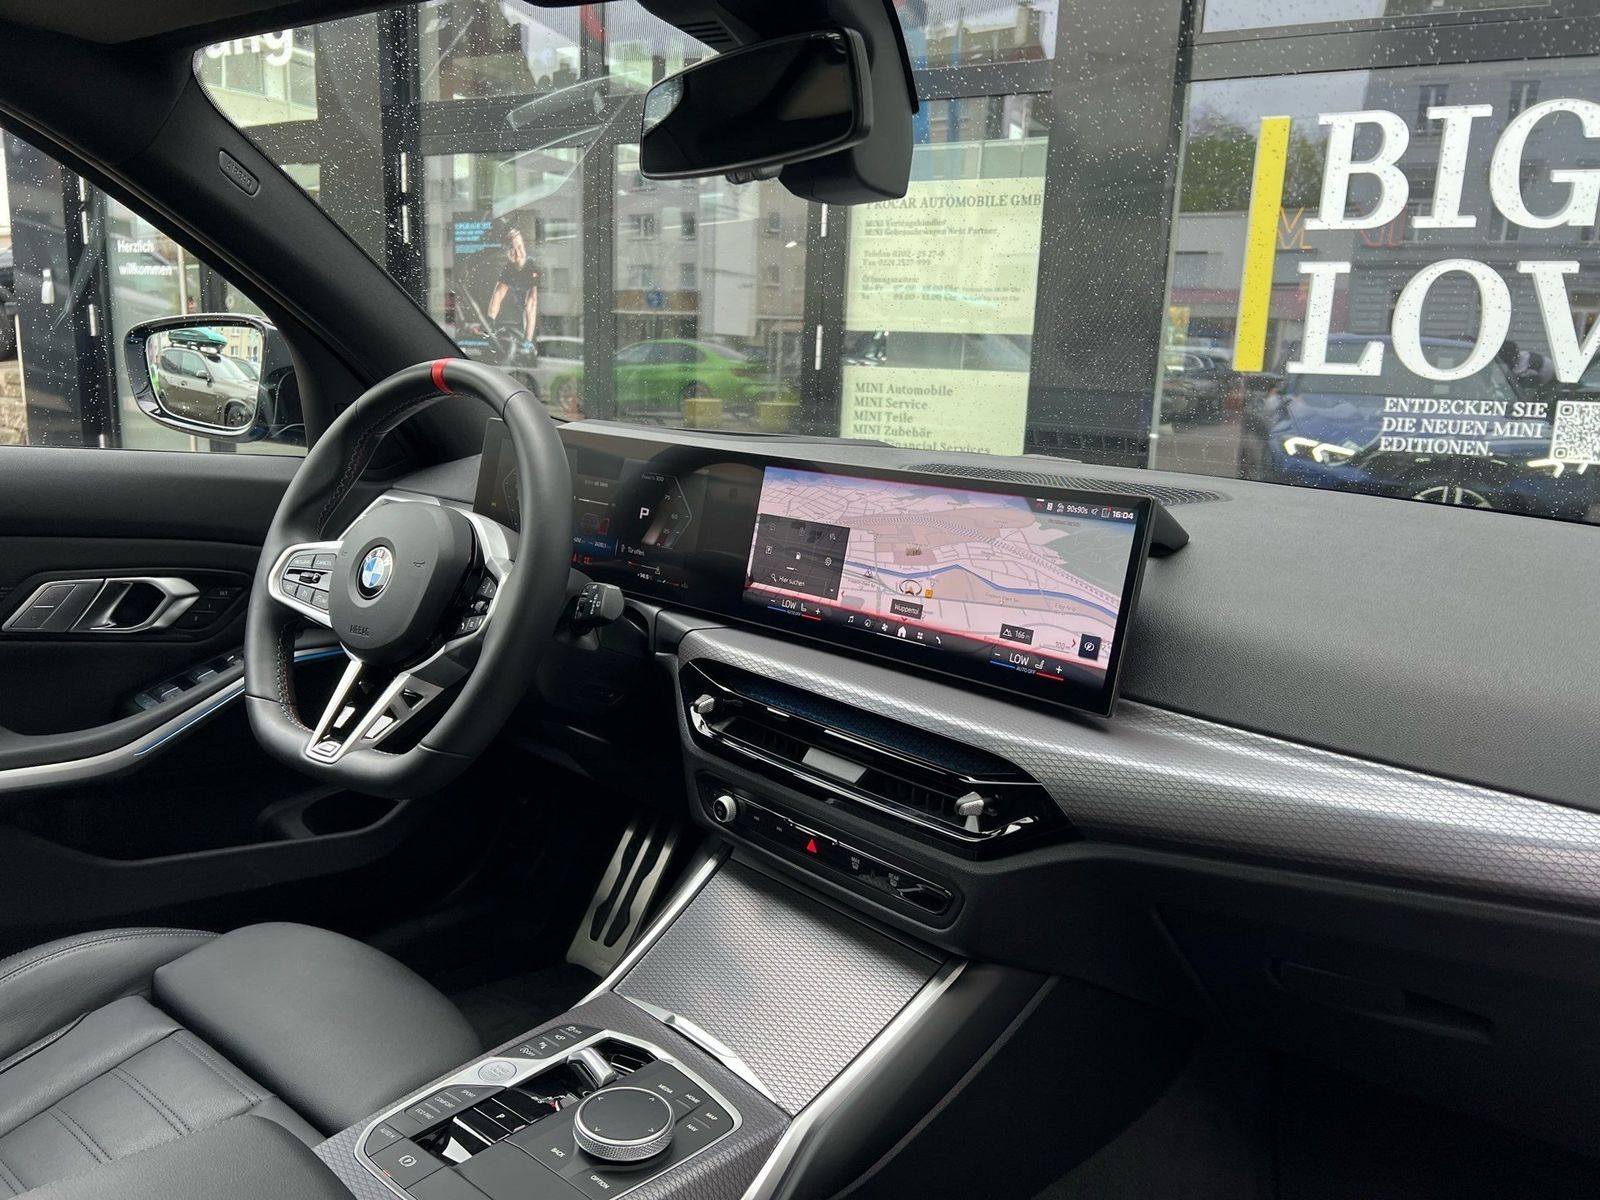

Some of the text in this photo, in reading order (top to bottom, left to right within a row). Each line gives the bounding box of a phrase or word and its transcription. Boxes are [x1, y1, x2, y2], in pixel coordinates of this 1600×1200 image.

[1304, 98, 1600, 231] BIG
[919, 195, 1008, 209] AUTOMOBILE
[117, 239, 154, 253] Herzlich
[119, 262, 173, 276] willkommen
[855, 382, 953, 397] MINI Automobile
[854, 396, 928, 410] MINI Service
[1383, 397, 1549, 418] ENTDECKEN SIE
[853, 410, 913, 424] MINI Teile
[852, 424, 933, 439] MINI Zubehör
[1381, 416, 1545, 439] DIE NEUEN MINI
[1378, 435, 1495, 457] EDITIONEN.
[639, 506, 650, 519] P
[1066, 504, 1089, 515] 90s90s
[1112, 510, 1135, 520] 16:04
[781, 599, 798, 610] LOW
[894, 603, 920, 615] Wuppertal
[1015, 630, 1026, 639] 166
[1009, 652, 1030, 666] LOW
[550, 1147, 566, 1159] BACK
[590, 1174, 611, 1190] OPTION
